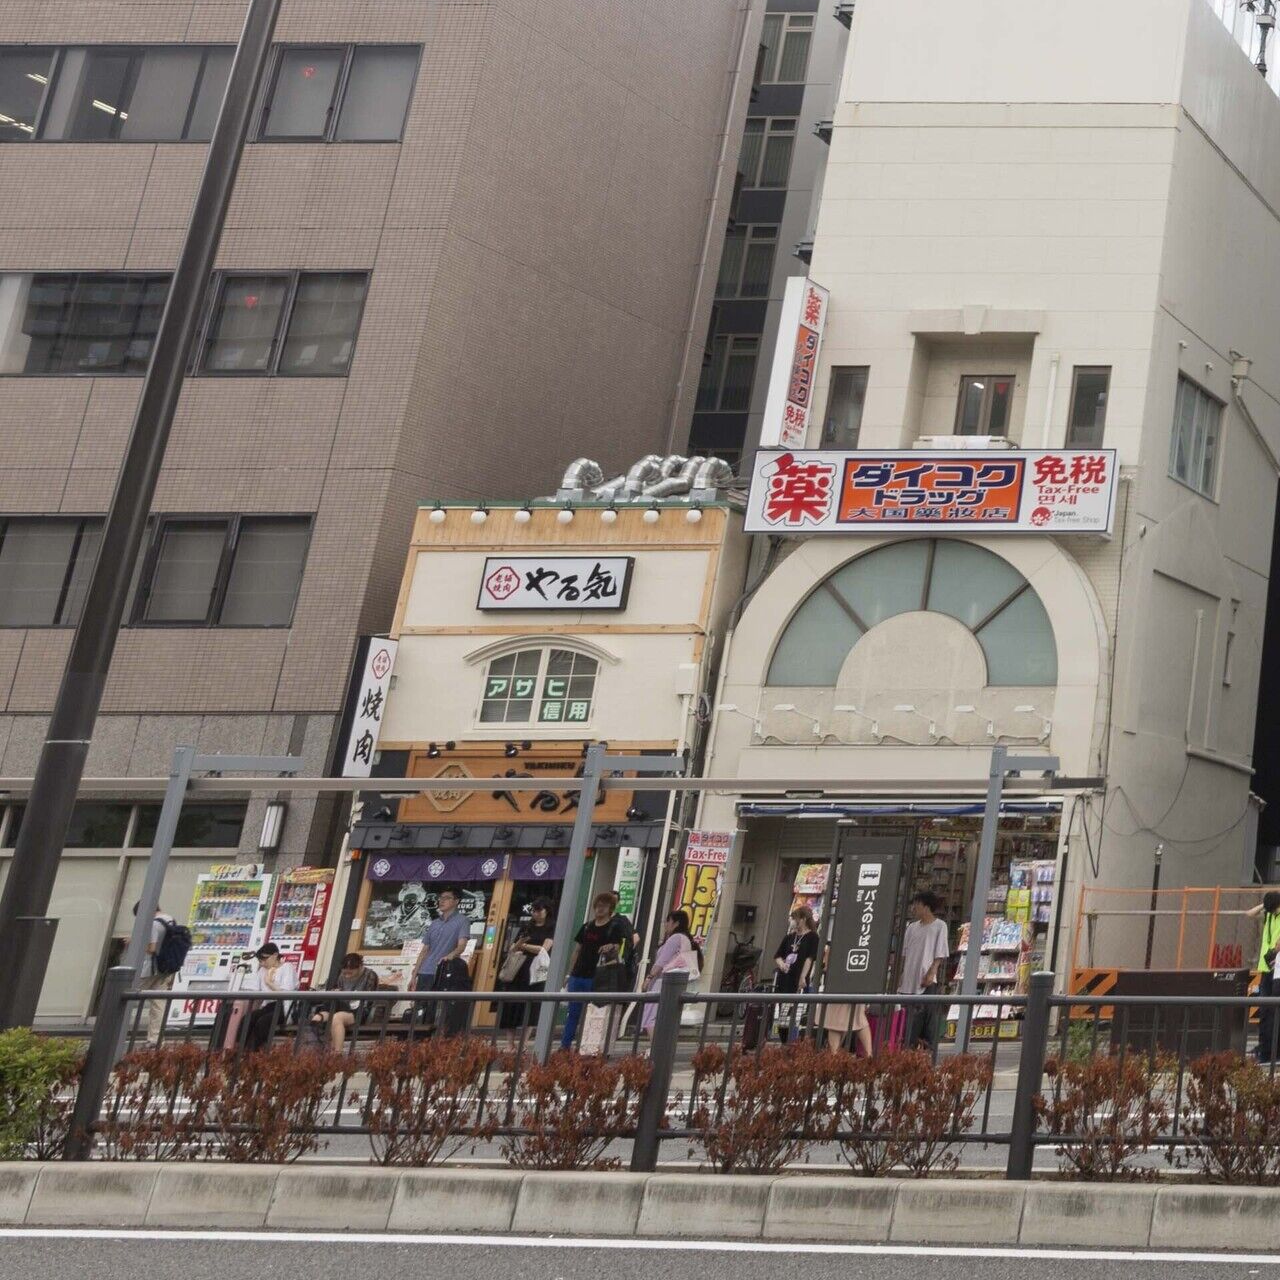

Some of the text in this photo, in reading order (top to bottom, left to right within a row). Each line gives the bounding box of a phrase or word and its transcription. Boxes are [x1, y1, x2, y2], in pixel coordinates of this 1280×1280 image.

[852, 463, 1017, 489] ダイコク
[1033, 455, 1107, 485] 免税
[766, 453, 832, 523] 薬
[873, 488, 987, 507] ドラッグ
[1037, 485, 1100, 494] Tax-Free
[1038, 495, 1078, 505] 면세
[525, 562, 617, 604] やる気
[488, 679, 565, 697] アサヒ
[543, 702, 588, 720] 信用
[353, 686, 384, 766] 焼肉
[687, 847, 728, 860] Tax-Free
[859, 889, 877, 947] バスのりば
[849, 954, 867, 966] G2
